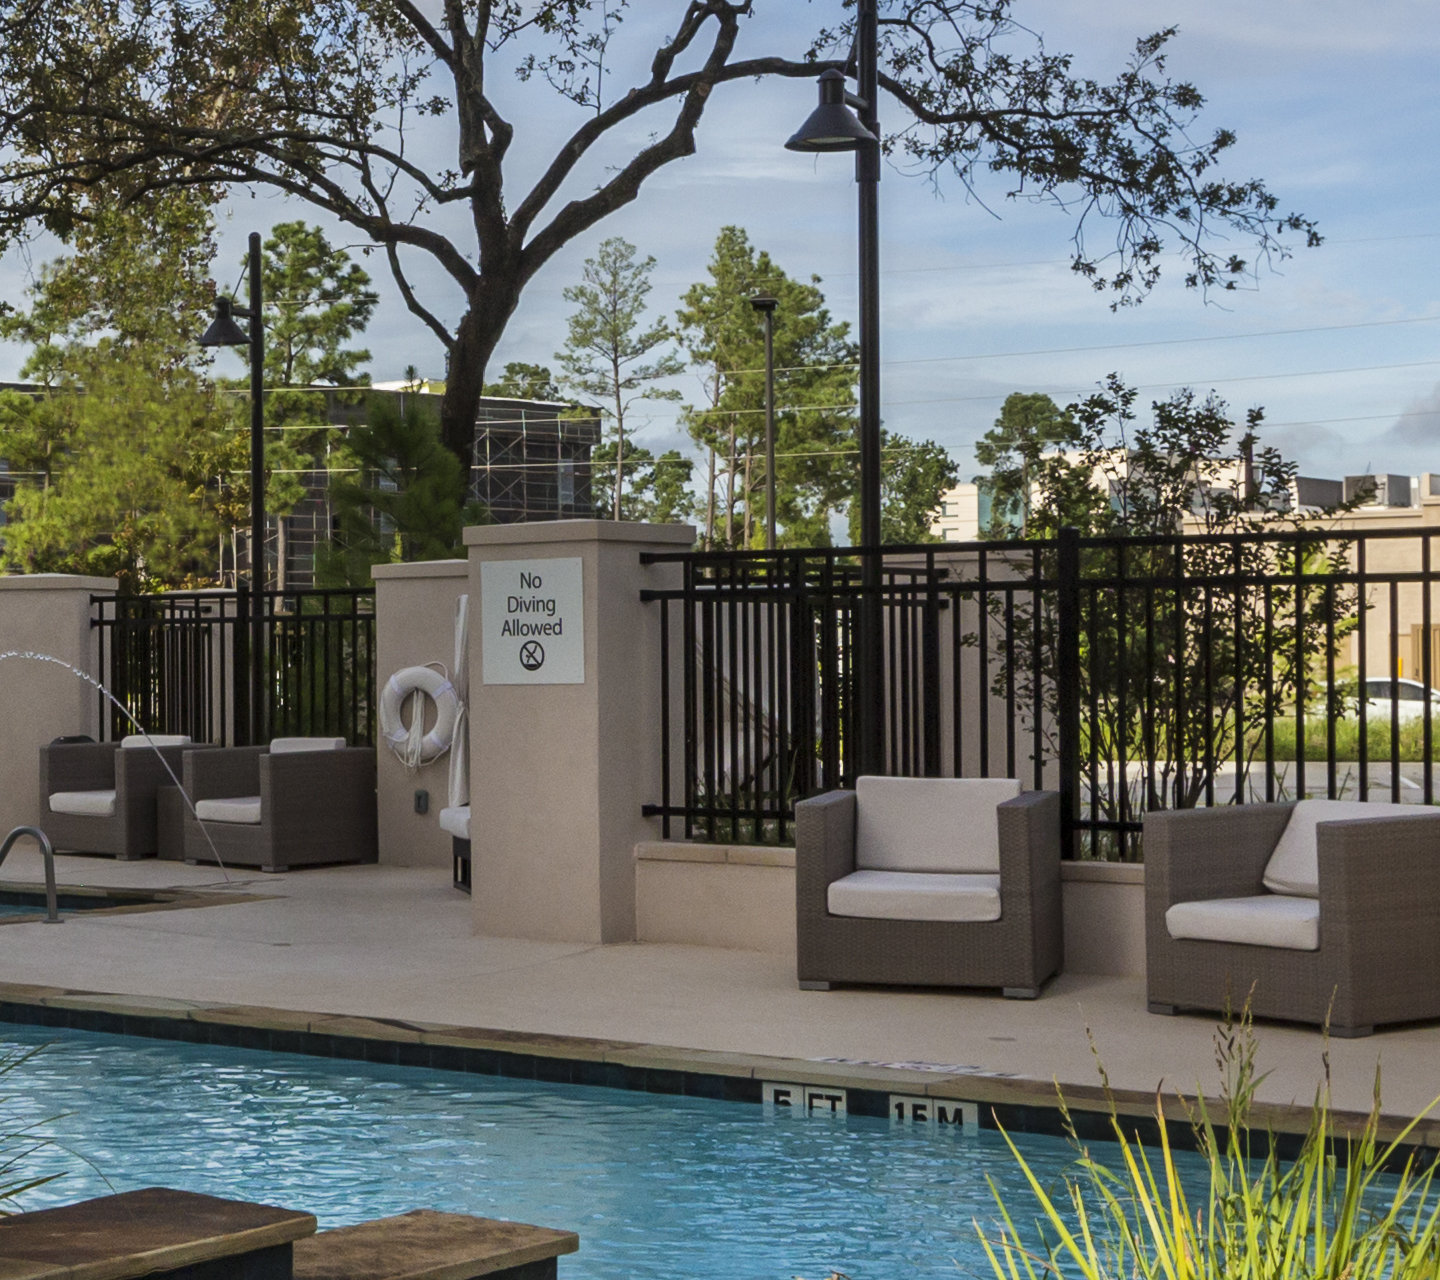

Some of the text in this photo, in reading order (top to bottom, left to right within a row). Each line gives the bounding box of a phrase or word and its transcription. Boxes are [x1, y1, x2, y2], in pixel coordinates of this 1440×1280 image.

[520, 572, 542, 589] No
[507, 596, 555, 616] Diving
[501, 618, 563, 636] Allowed
